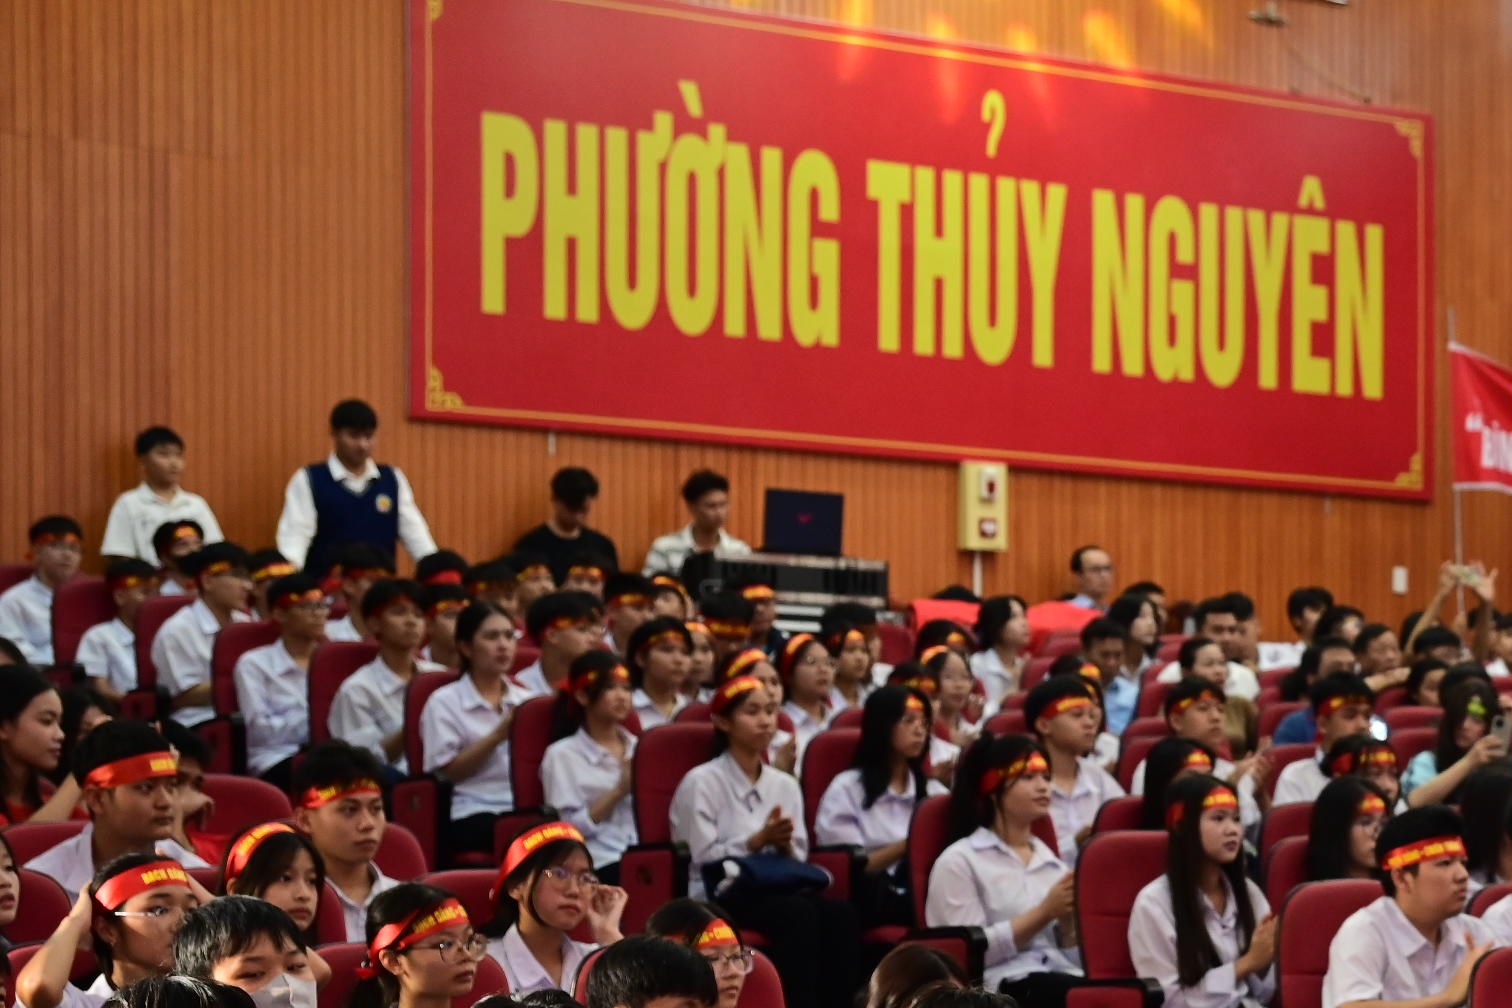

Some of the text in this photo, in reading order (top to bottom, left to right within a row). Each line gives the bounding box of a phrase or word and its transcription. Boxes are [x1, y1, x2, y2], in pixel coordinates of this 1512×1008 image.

[480, 79, 1384, 401] PHƯỜNG THỦY NGUYÊN
